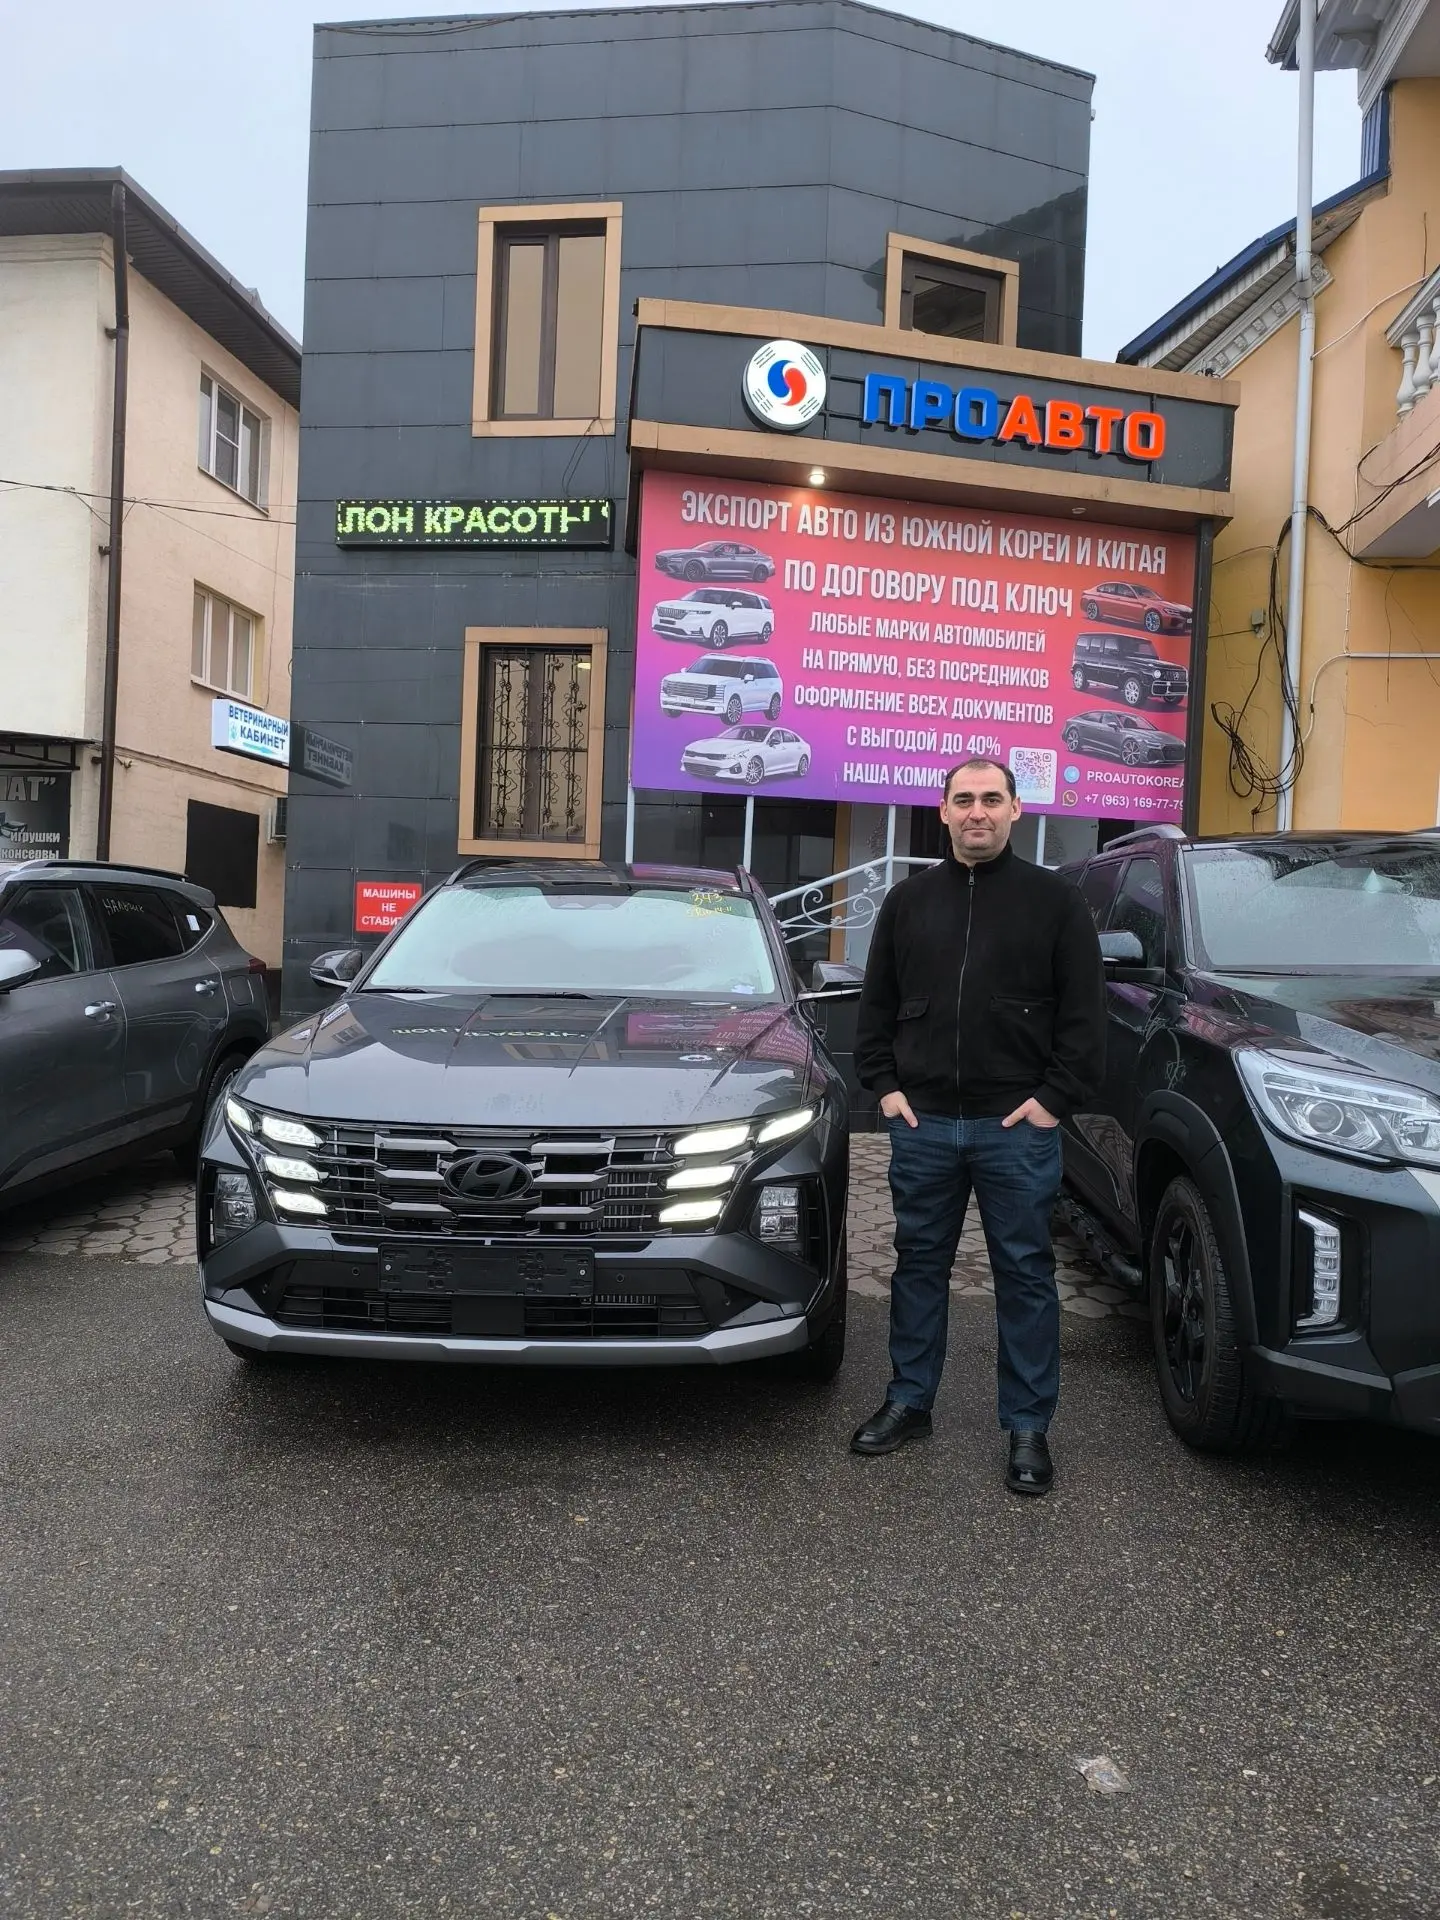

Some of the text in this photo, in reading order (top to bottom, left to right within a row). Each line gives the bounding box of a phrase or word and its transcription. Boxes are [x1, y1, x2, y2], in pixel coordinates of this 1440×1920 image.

[862, 372, 1166, 461] ПРОАВТО
[339, 506, 414, 534] ЛОН
[681, 490, 1167, 575] ЭКСПОРТ АВТО ИЗ ЮЖНОЙ КОРЕИ И КИТАЯ
[784, 559, 1073, 617] ПО ДОГОВОРУ ПОД КЛЮЧ
[809, 611, 1046, 653] ЛЮБЫЕ МАРКИ АВТОМОБИЛЕЙ
[802, 648, 1049, 689] НА ПРЯМУЮ, БЕЗ ПОСРЕДНИКОВ
[794, 684, 1054, 725] ОФОРМЛЕНИЕ ВСЕХ ДОКУМЕНТОВ
[229, 705, 289, 736] ВЕТЕРИНАРНЫЙ
[240, 725, 286, 750] КАБИНЕТ
[847, 725, 1001, 757] С ВЫГОДОЙ ДО 40%
[843, 761, 947, 789] НАША КОМИС
[1084, 793, 1099, 804] +7
[1101, 794, 1130, 808] (963)
[11, 832, 60, 844] игрушки
[363, 888, 416, 900] МАШИНЫ
[381, 902, 397, 912] НЕ
